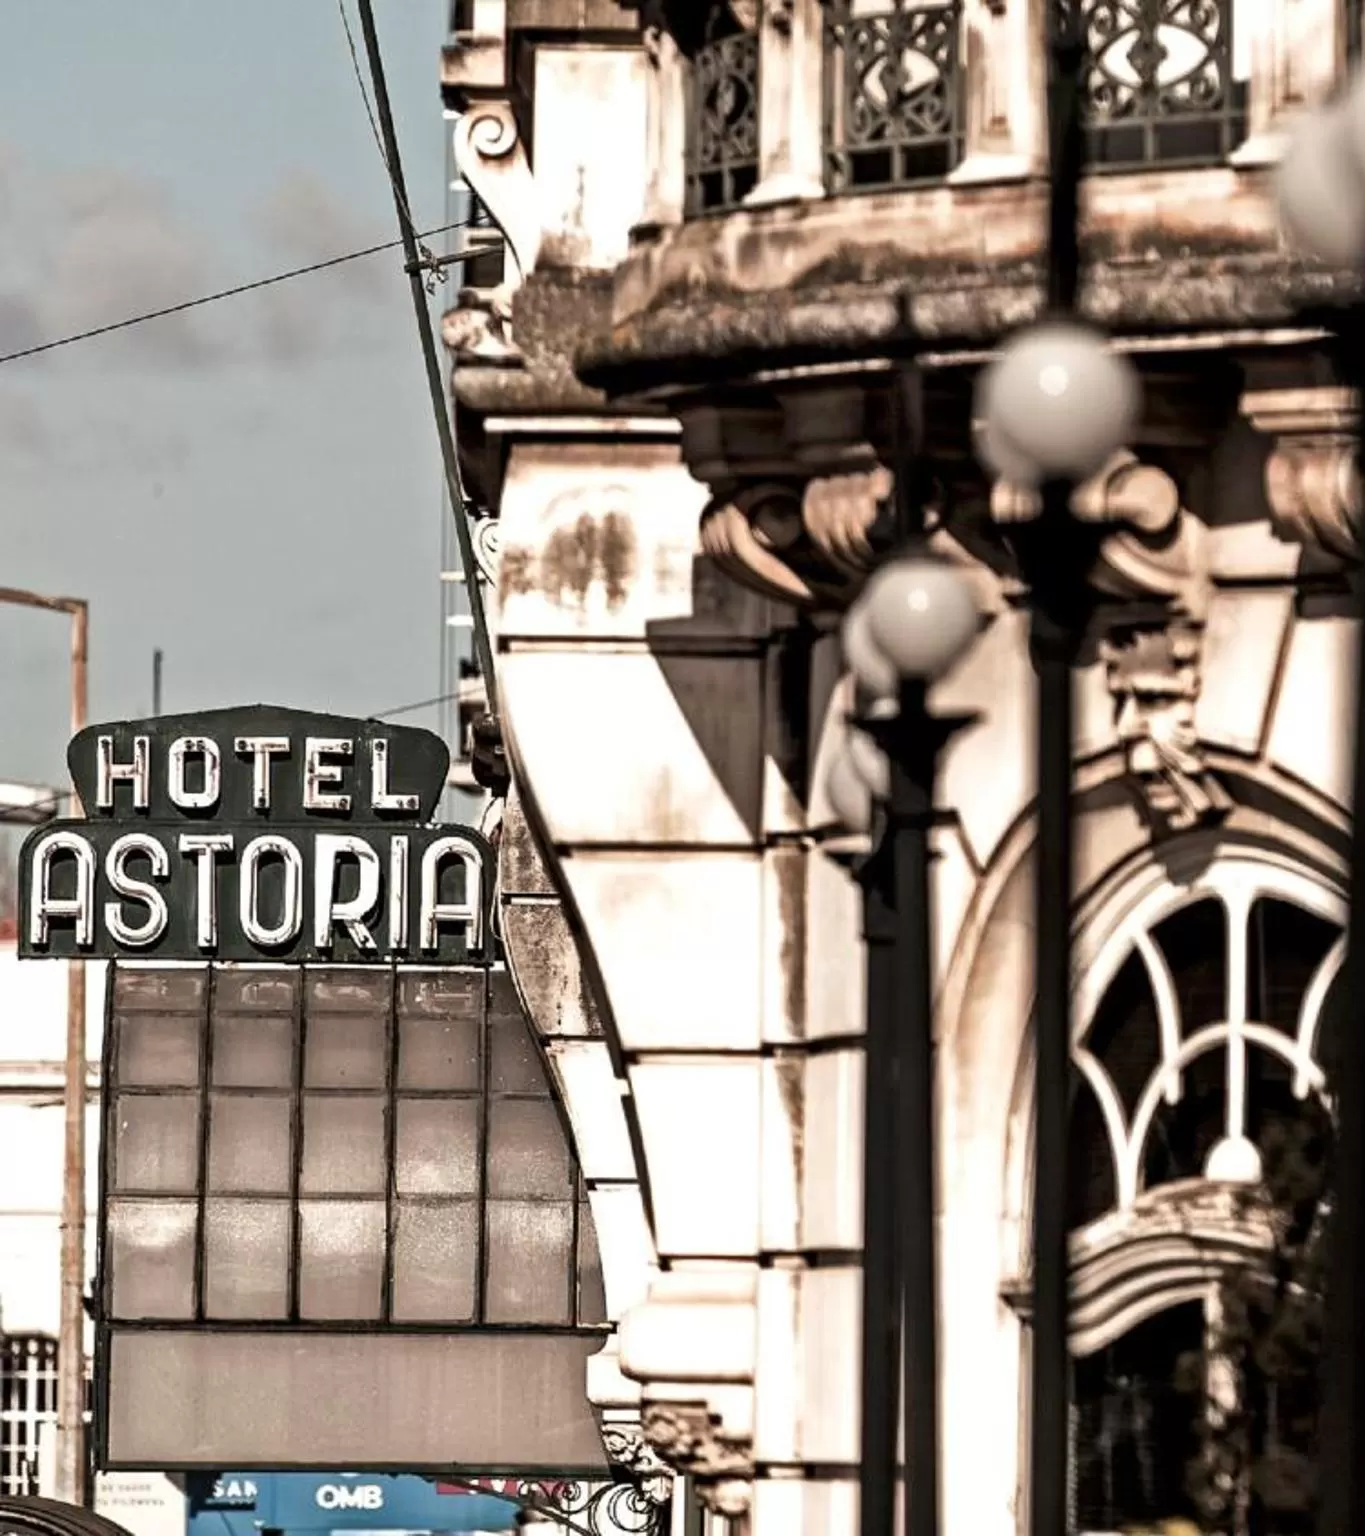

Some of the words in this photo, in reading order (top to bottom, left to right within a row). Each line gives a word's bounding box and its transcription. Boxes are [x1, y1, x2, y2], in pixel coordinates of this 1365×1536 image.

[97, 736, 419, 811] HOTEL
[31, 832, 483, 950] ASTORIA
[316, 1484, 383, 1510] OMB
